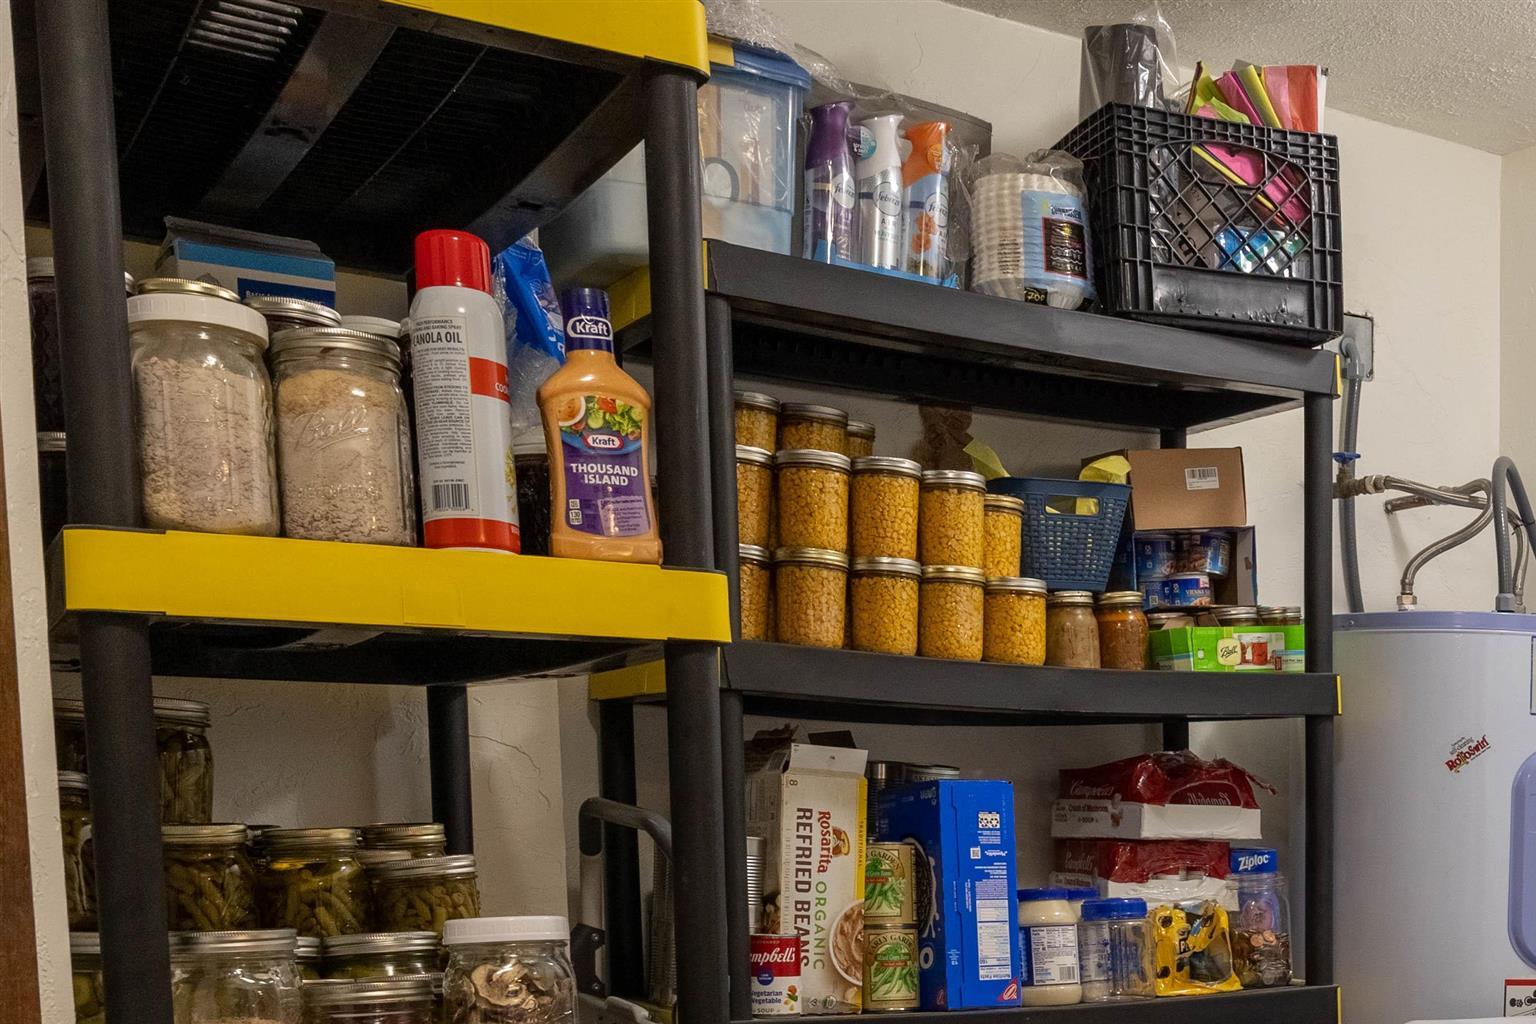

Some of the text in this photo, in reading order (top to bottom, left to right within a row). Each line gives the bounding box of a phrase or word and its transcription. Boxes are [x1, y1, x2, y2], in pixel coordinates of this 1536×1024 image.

[575, 321, 608, 336] Kraft
[445, 330, 463, 344] OIL
[591, 436, 617, 447] Kraft
[570, 463, 639, 477] THOUSAND
[584, 474, 629, 486] ISLAND
[795, 807, 813, 893] REFRIED
[1238, 854, 1270, 871] Ziploc
[813, 810, 833, 970] Rosarita ORGANIC
[751, 947, 796, 966] mpbell's
